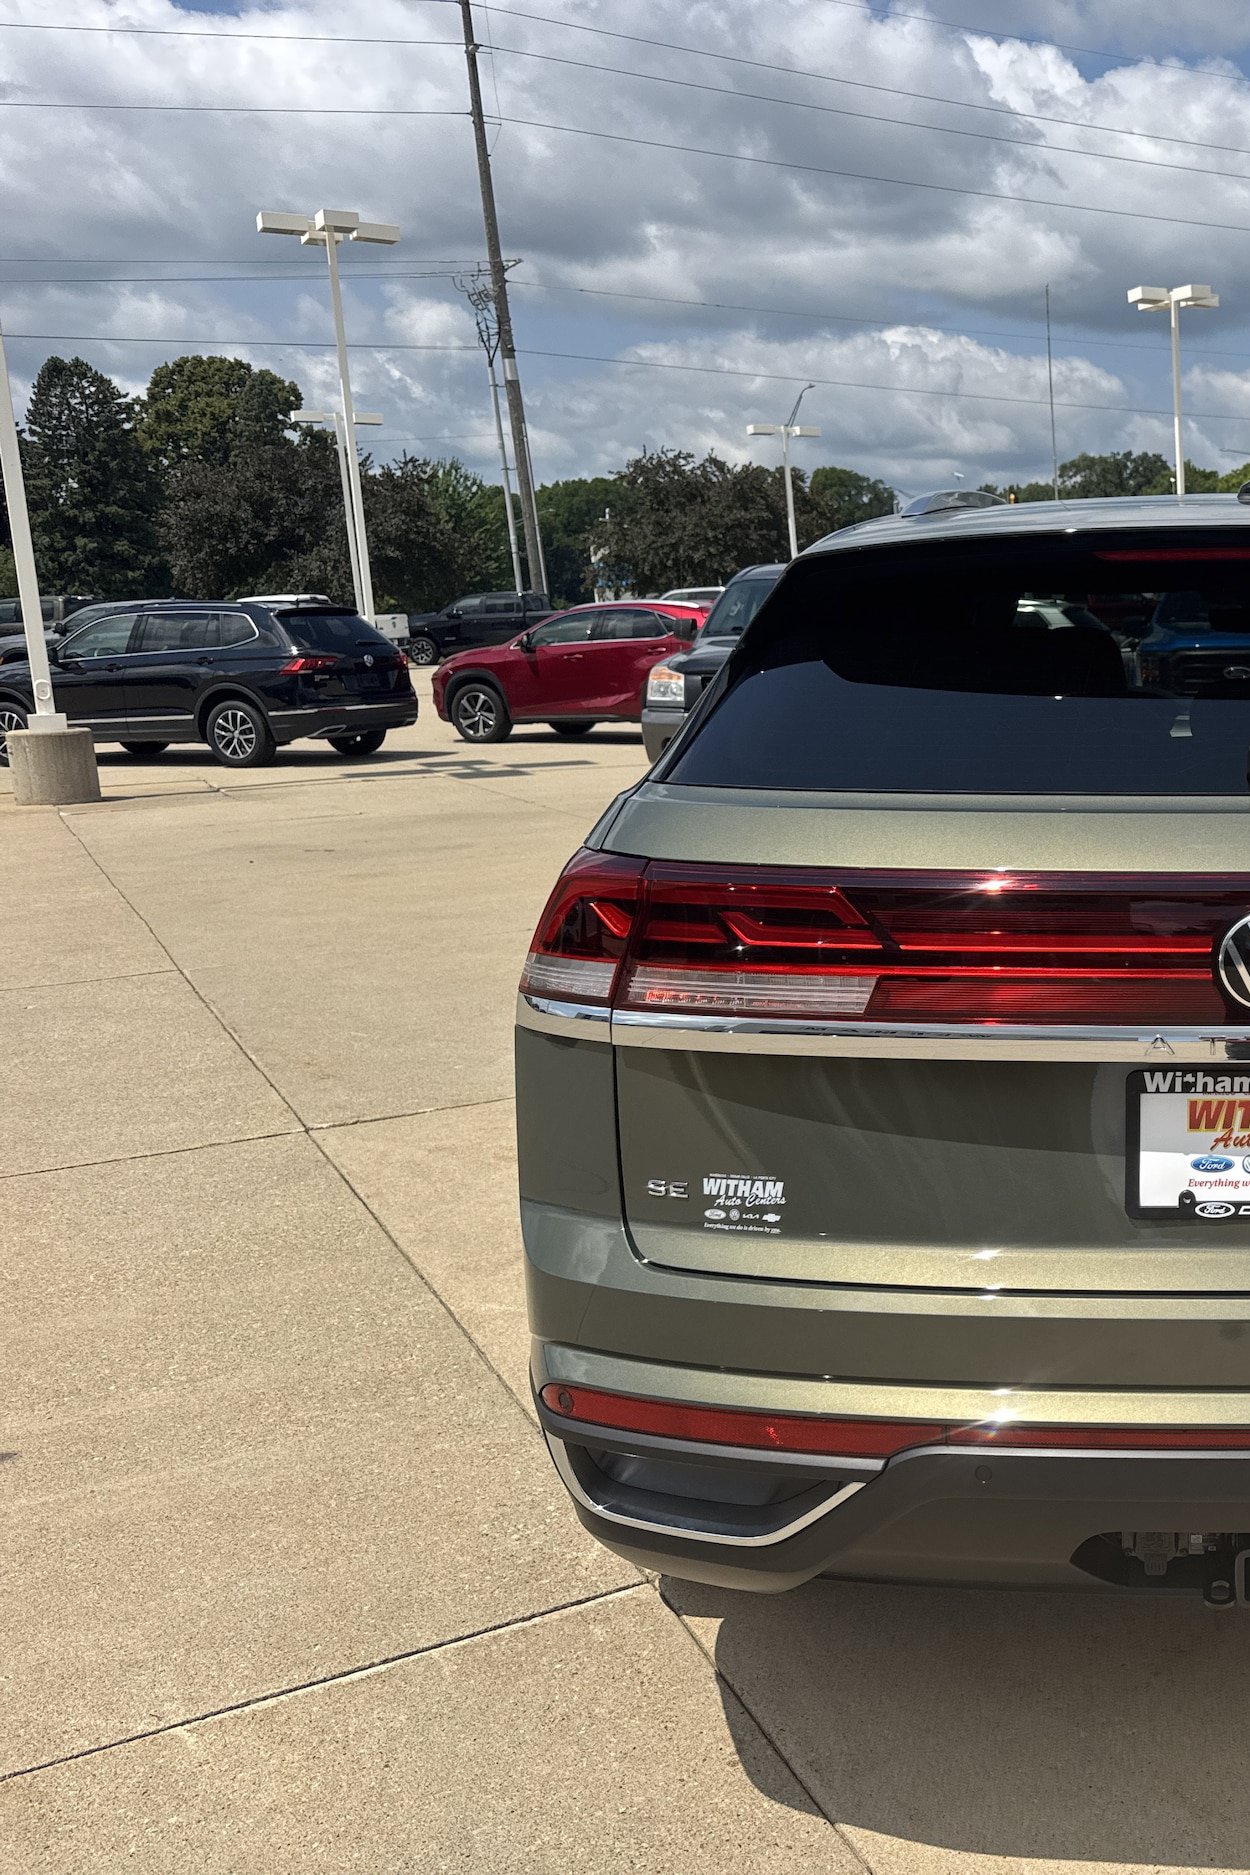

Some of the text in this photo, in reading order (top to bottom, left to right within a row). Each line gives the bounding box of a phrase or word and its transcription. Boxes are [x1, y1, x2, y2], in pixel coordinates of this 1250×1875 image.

[1199, 1158, 1225, 1170] Ford
[647, 1180, 689, 1198] SE
[703, 1178, 785, 1197] WITHAM
[1188, 1179, 1240, 1189] Everything
[714, 1193, 786, 1207] Auto Centers
